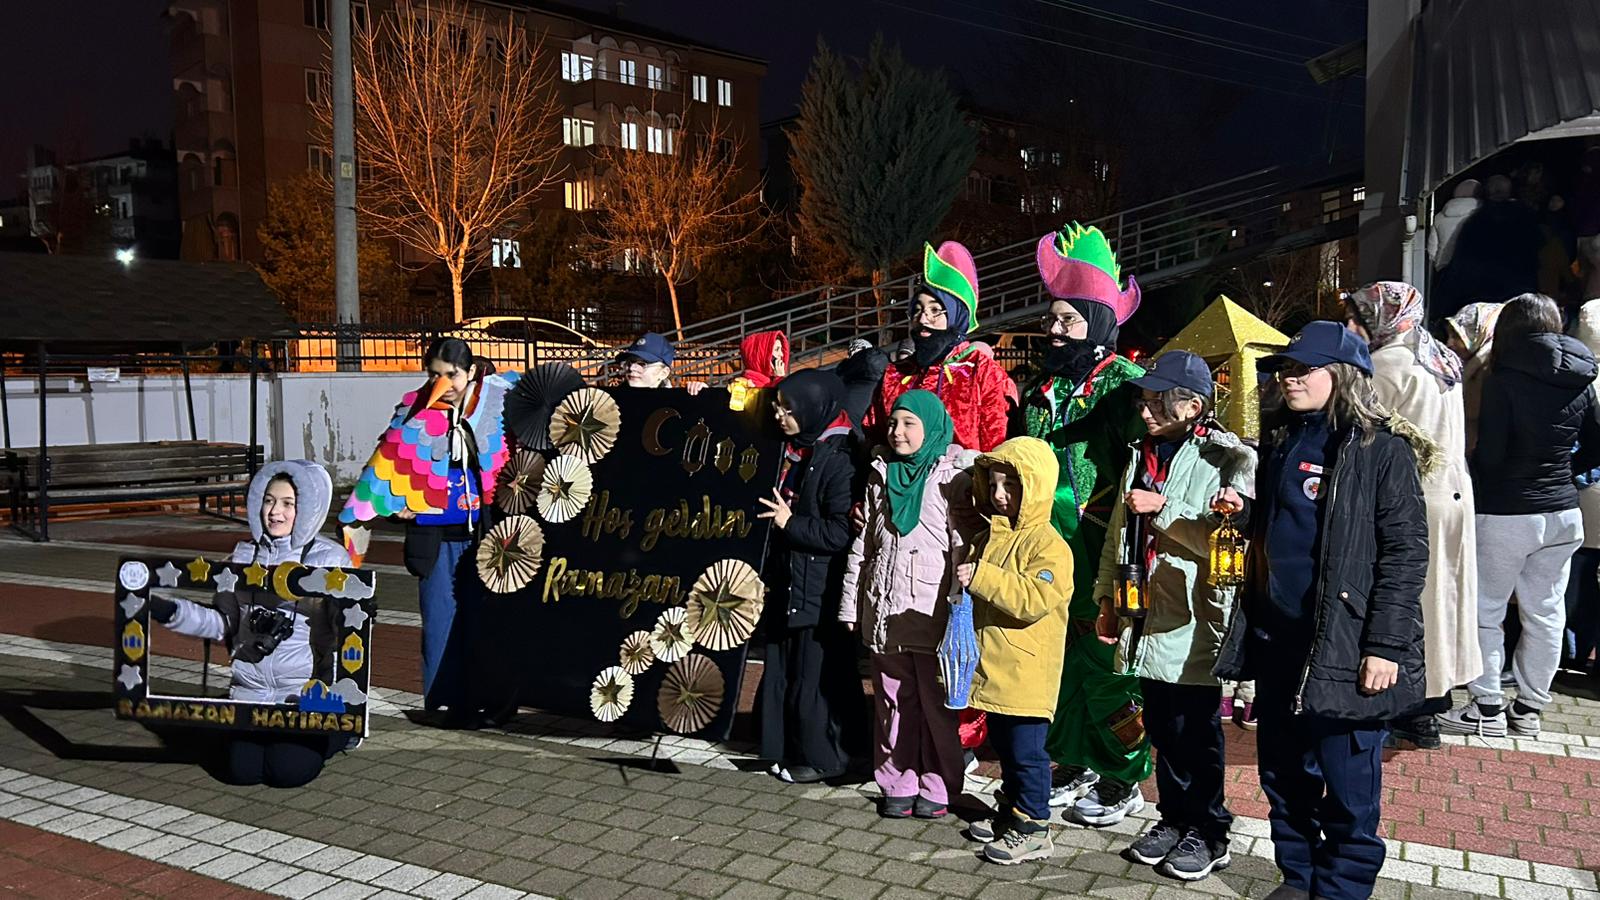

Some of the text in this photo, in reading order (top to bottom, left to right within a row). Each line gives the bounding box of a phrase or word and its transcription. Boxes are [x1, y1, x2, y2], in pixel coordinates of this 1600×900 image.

[640, 494, 752, 551] geldin
[542, 556, 686, 619] Ramazan
[117, 700, 362, 733] RAMAZAN HATIRASI
